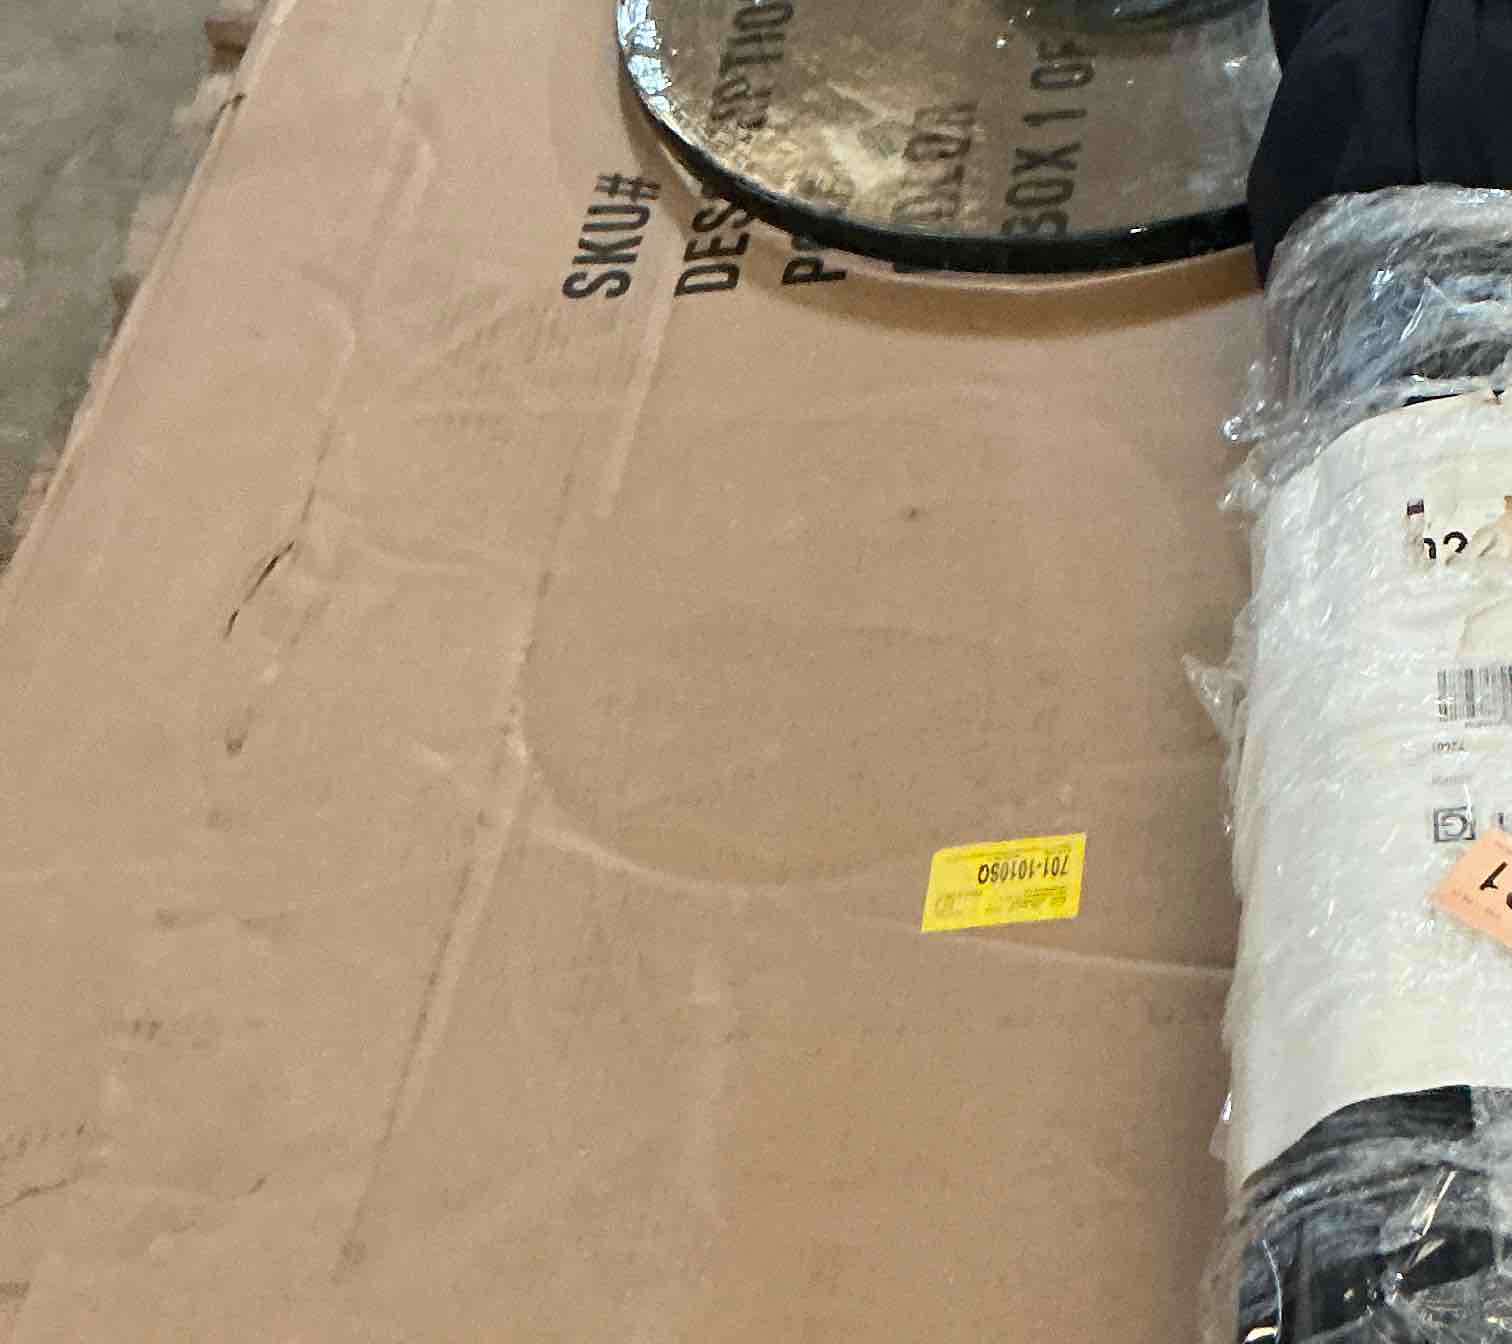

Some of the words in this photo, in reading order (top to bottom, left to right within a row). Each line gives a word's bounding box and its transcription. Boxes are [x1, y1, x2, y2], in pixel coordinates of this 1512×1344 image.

[1029, 39, 1096, 93] OF
[1021, 107, 1087, 130] 1
[1000, 140, 1084, 241] BOX
[562, 172, 661, 299] SKU#
